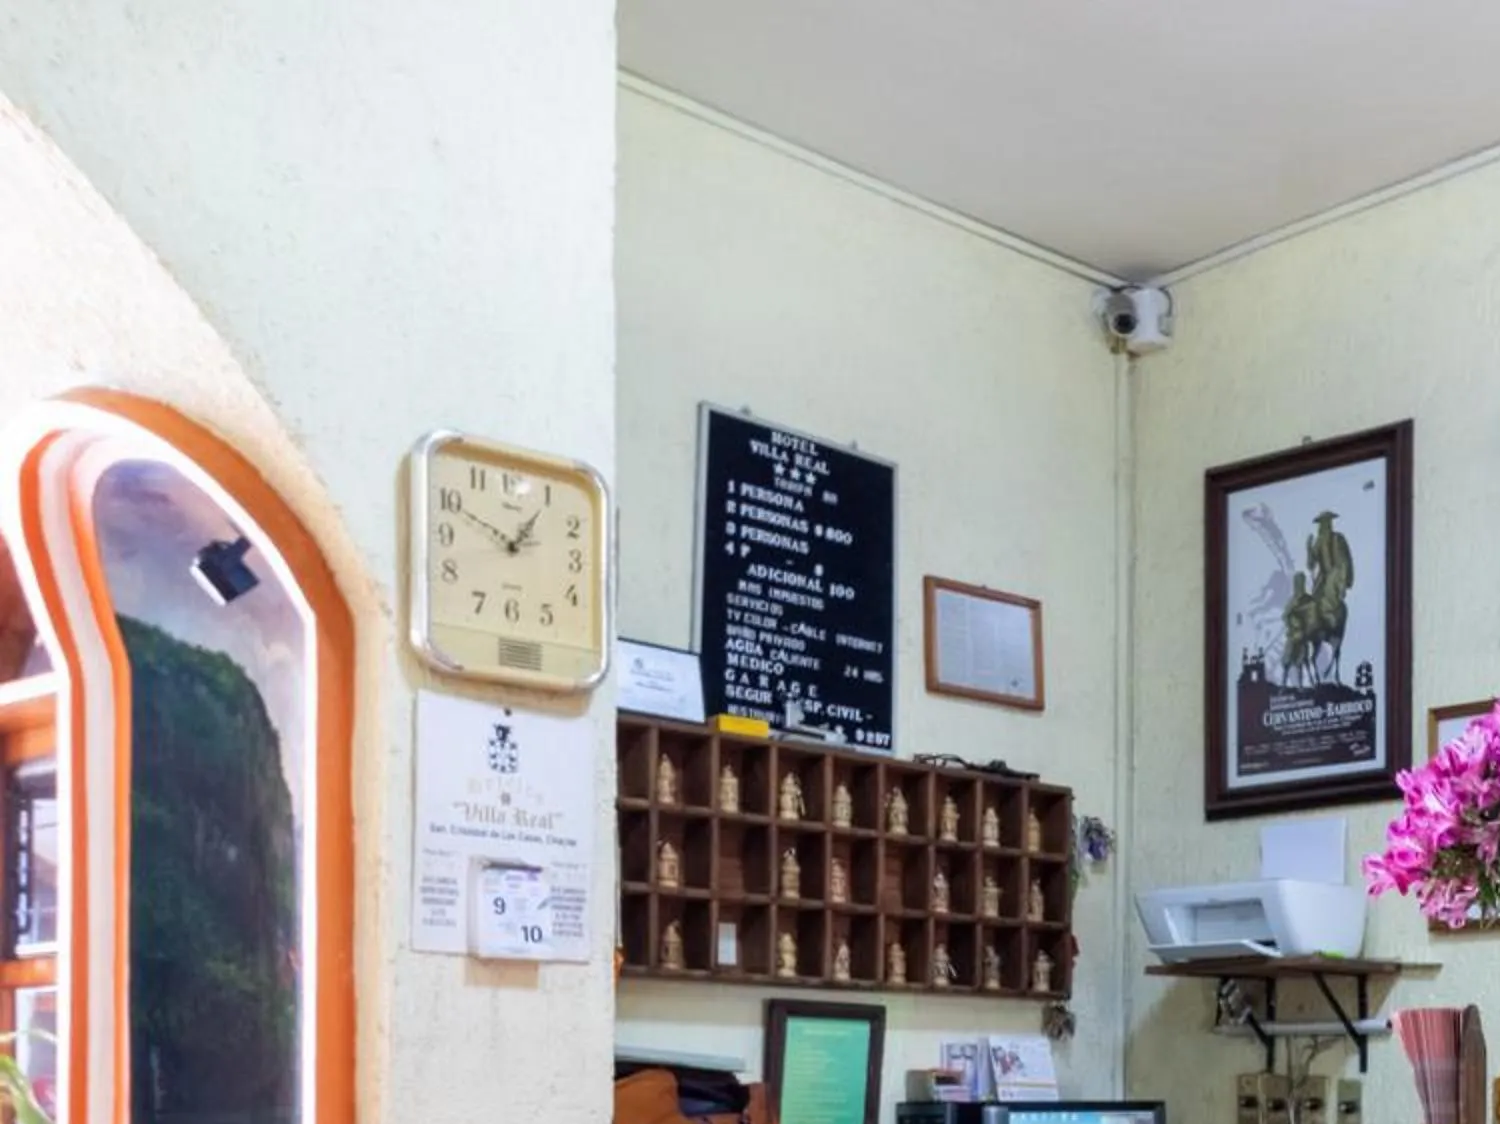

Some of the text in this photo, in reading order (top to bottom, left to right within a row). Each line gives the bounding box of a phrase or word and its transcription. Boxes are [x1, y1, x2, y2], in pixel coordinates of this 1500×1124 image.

[772, 432, 819, 455] HOTEL
[749, 440, 831, 476] VILLA REAL
[469, 465, 486, 492] 11
[544, 484, 551, 508] 1
[740, 482, 804, 512] PERSONA
[440, 487, 461, 514] 10
[566, 515, 581, 540] 2
[740, 503, 809, 533] PERSONAS
[438, 523, 455, 546] 9
[741, 525, 809, 554] PERSONAS
[441, 558, 458, 584] 8
[568, 549, 582, 574] 3
[747, 562, 823, 592] ADICIONAL
[471, 590, 554, 626] 7 6 5
[565, 583, 579, 607] 4
[726, 592, 784, 616] SERVICIOS
[726, 608, 742, 622] TV
[835, 633, 884, 654] INTERNET
[759, 631, 806, 651] PRIVADO
[725, 638, 764, 656] AGUA
[770, 648, 821, 671] CALIENTE
[727, 652, 785, 675] MEDICO
[493, 897, 506, 915] 9
[521, 925, 543, 943] 10
